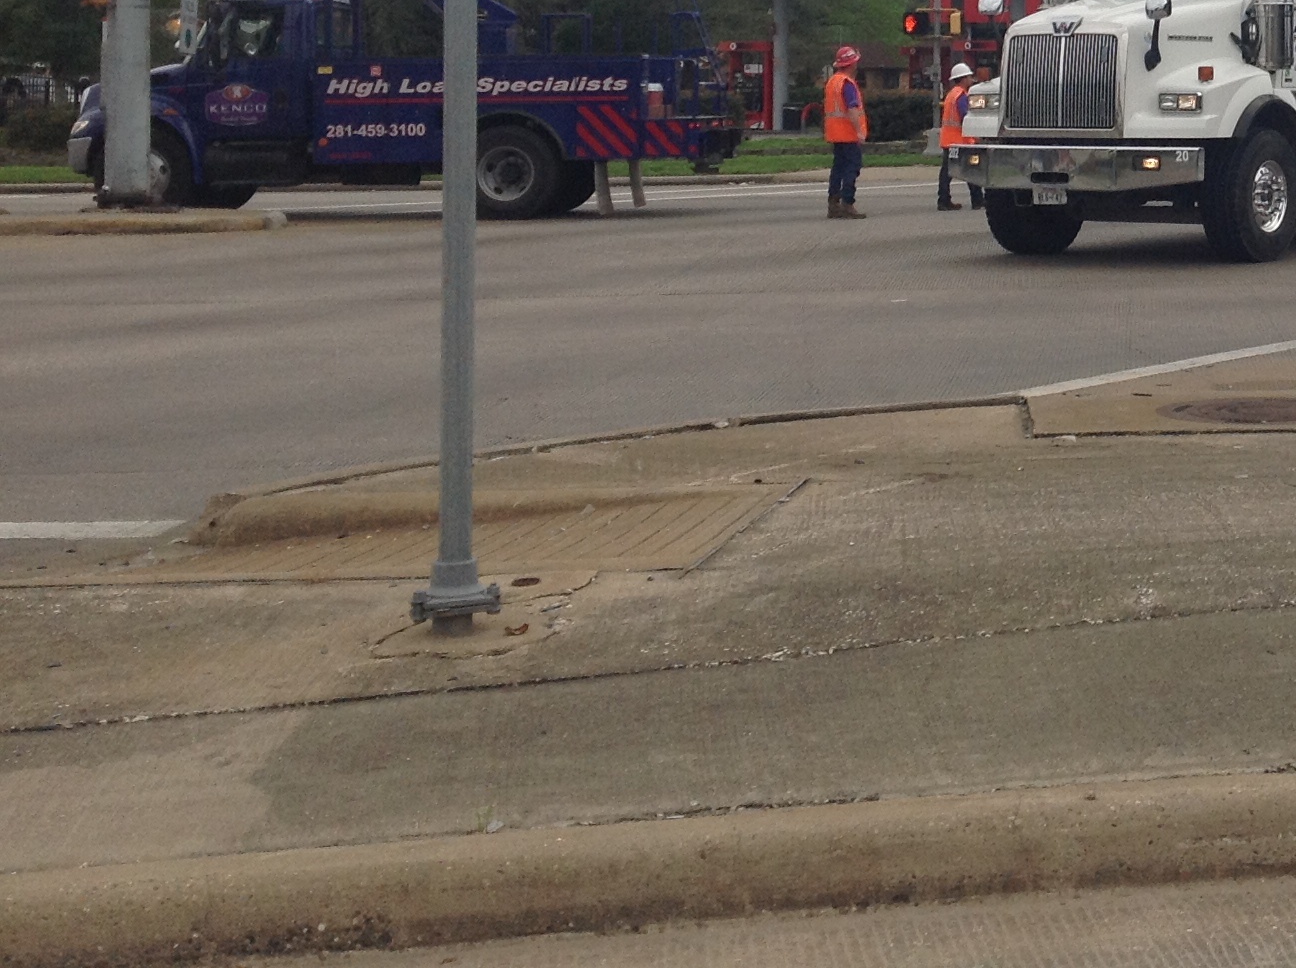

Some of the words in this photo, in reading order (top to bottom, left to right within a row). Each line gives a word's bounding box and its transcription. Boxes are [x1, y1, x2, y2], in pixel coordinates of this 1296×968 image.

[327, 78, 389, 97] High
[400, 78, 445, 95] Loa
[477, 77, 628, 96] Specialists
[326, 123, 426, 138] 281-459-3100
[1175, 150, 1189, 162] 20
